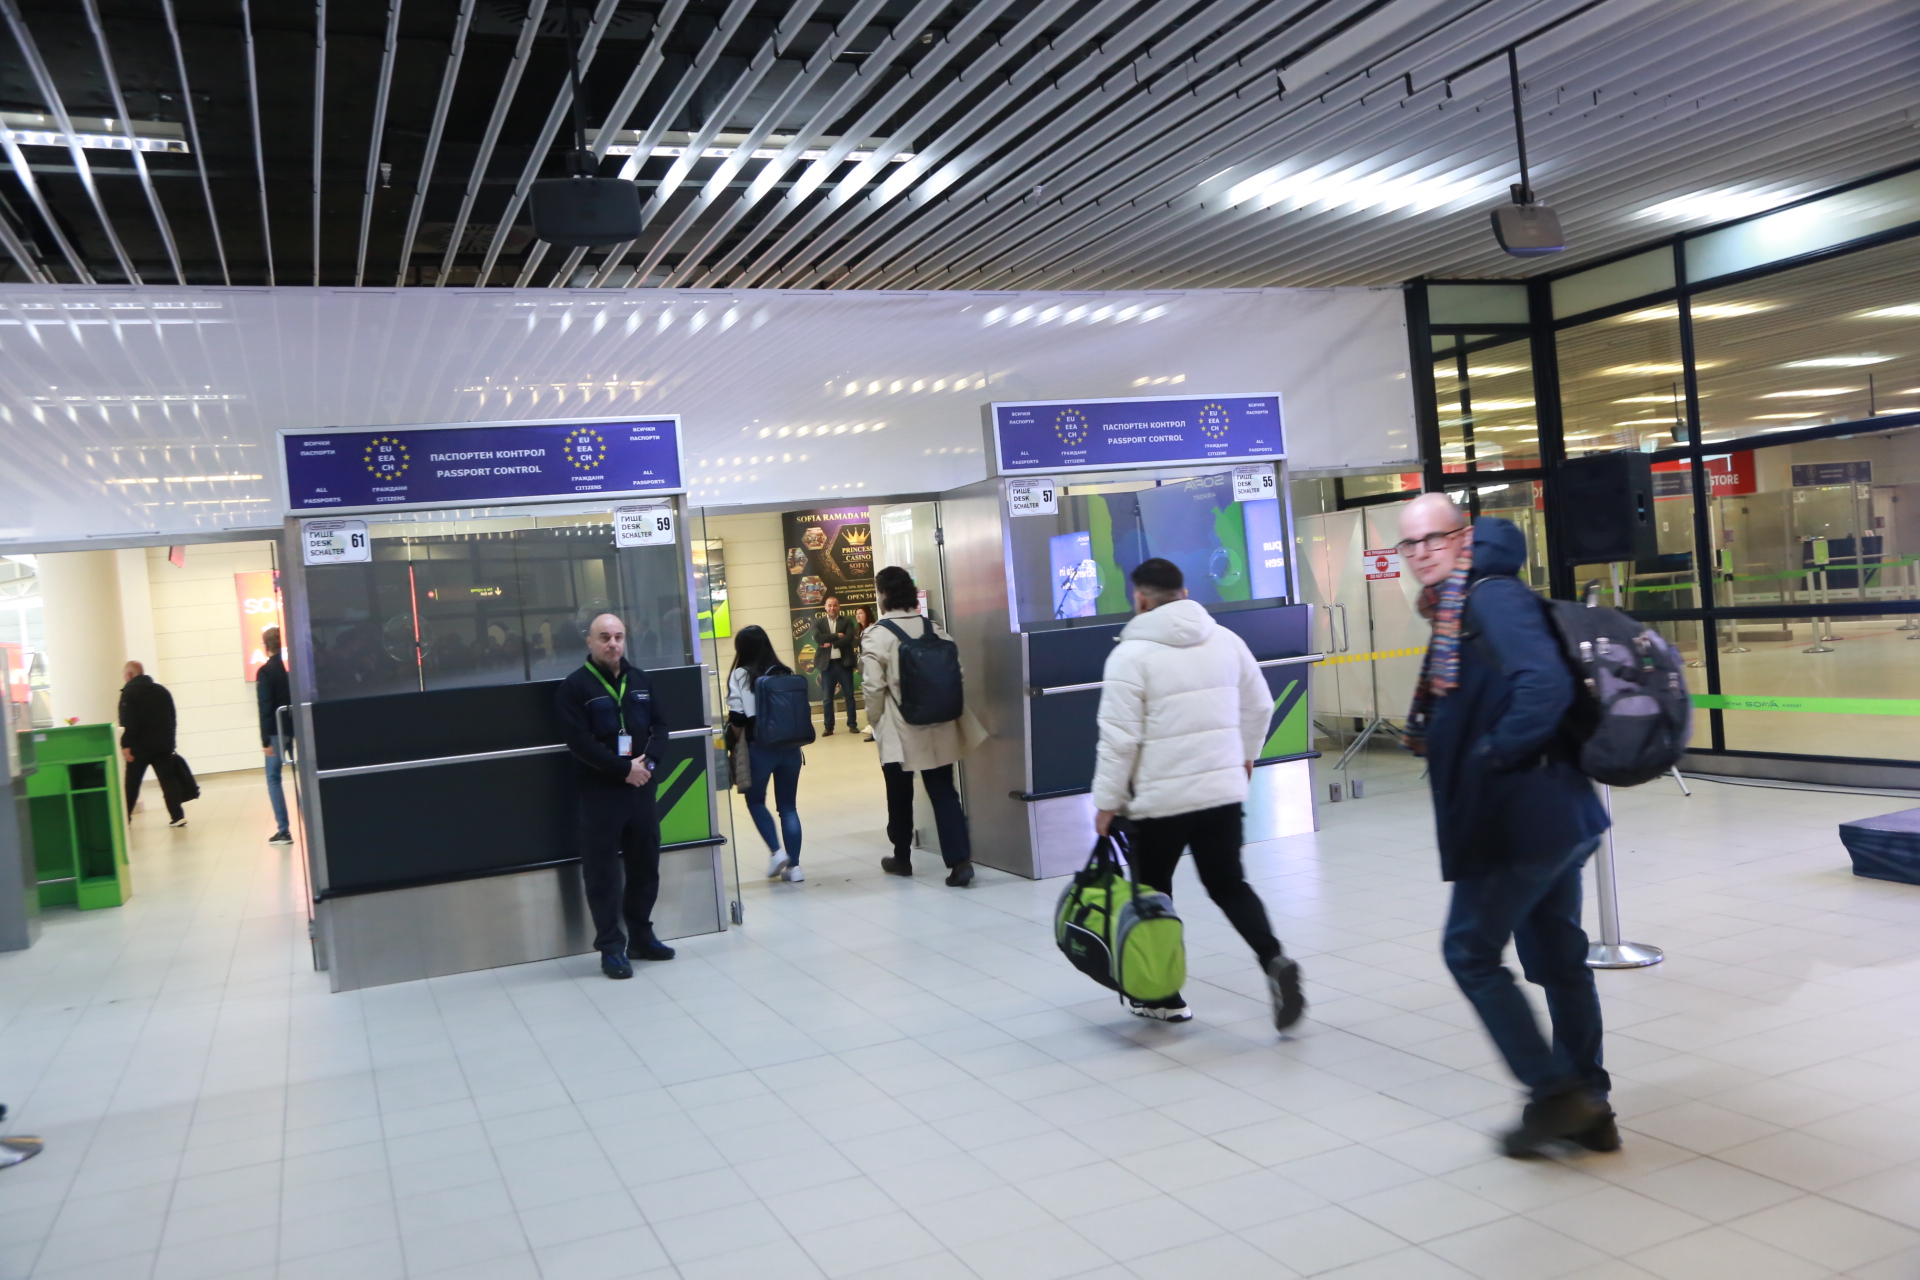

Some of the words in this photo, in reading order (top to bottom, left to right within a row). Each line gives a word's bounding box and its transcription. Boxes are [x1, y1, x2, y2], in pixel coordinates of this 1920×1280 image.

[1103, 422, 1148, 430] ПАСПОРТЕН
[1108, 436, 1147, 444] PASSPORT
[430, 451, 493, 461] ПАСПОРТЕН
[496, 449, 545, 458] КОНТРОЛ
[437, 468, 491, 477] PASSPORT
[493, 465, 542, 475] CONTROL
[1262, 476, 1273, 487] 55
[1710, 474, 1739, 486] STORE
[1042, 490, 1053, 502] 57
[796, 514, 821, 523] SOFIA
[823, 512, 859, 521] RAMADA
[656, 517, 670, 531] 59
[351, 533, 364, 548] 61
[310, 548, 345, 556] SCHALTER
[842, 545, 872, 553] PRINCESS
[814, 610, 845, 619] GRD
